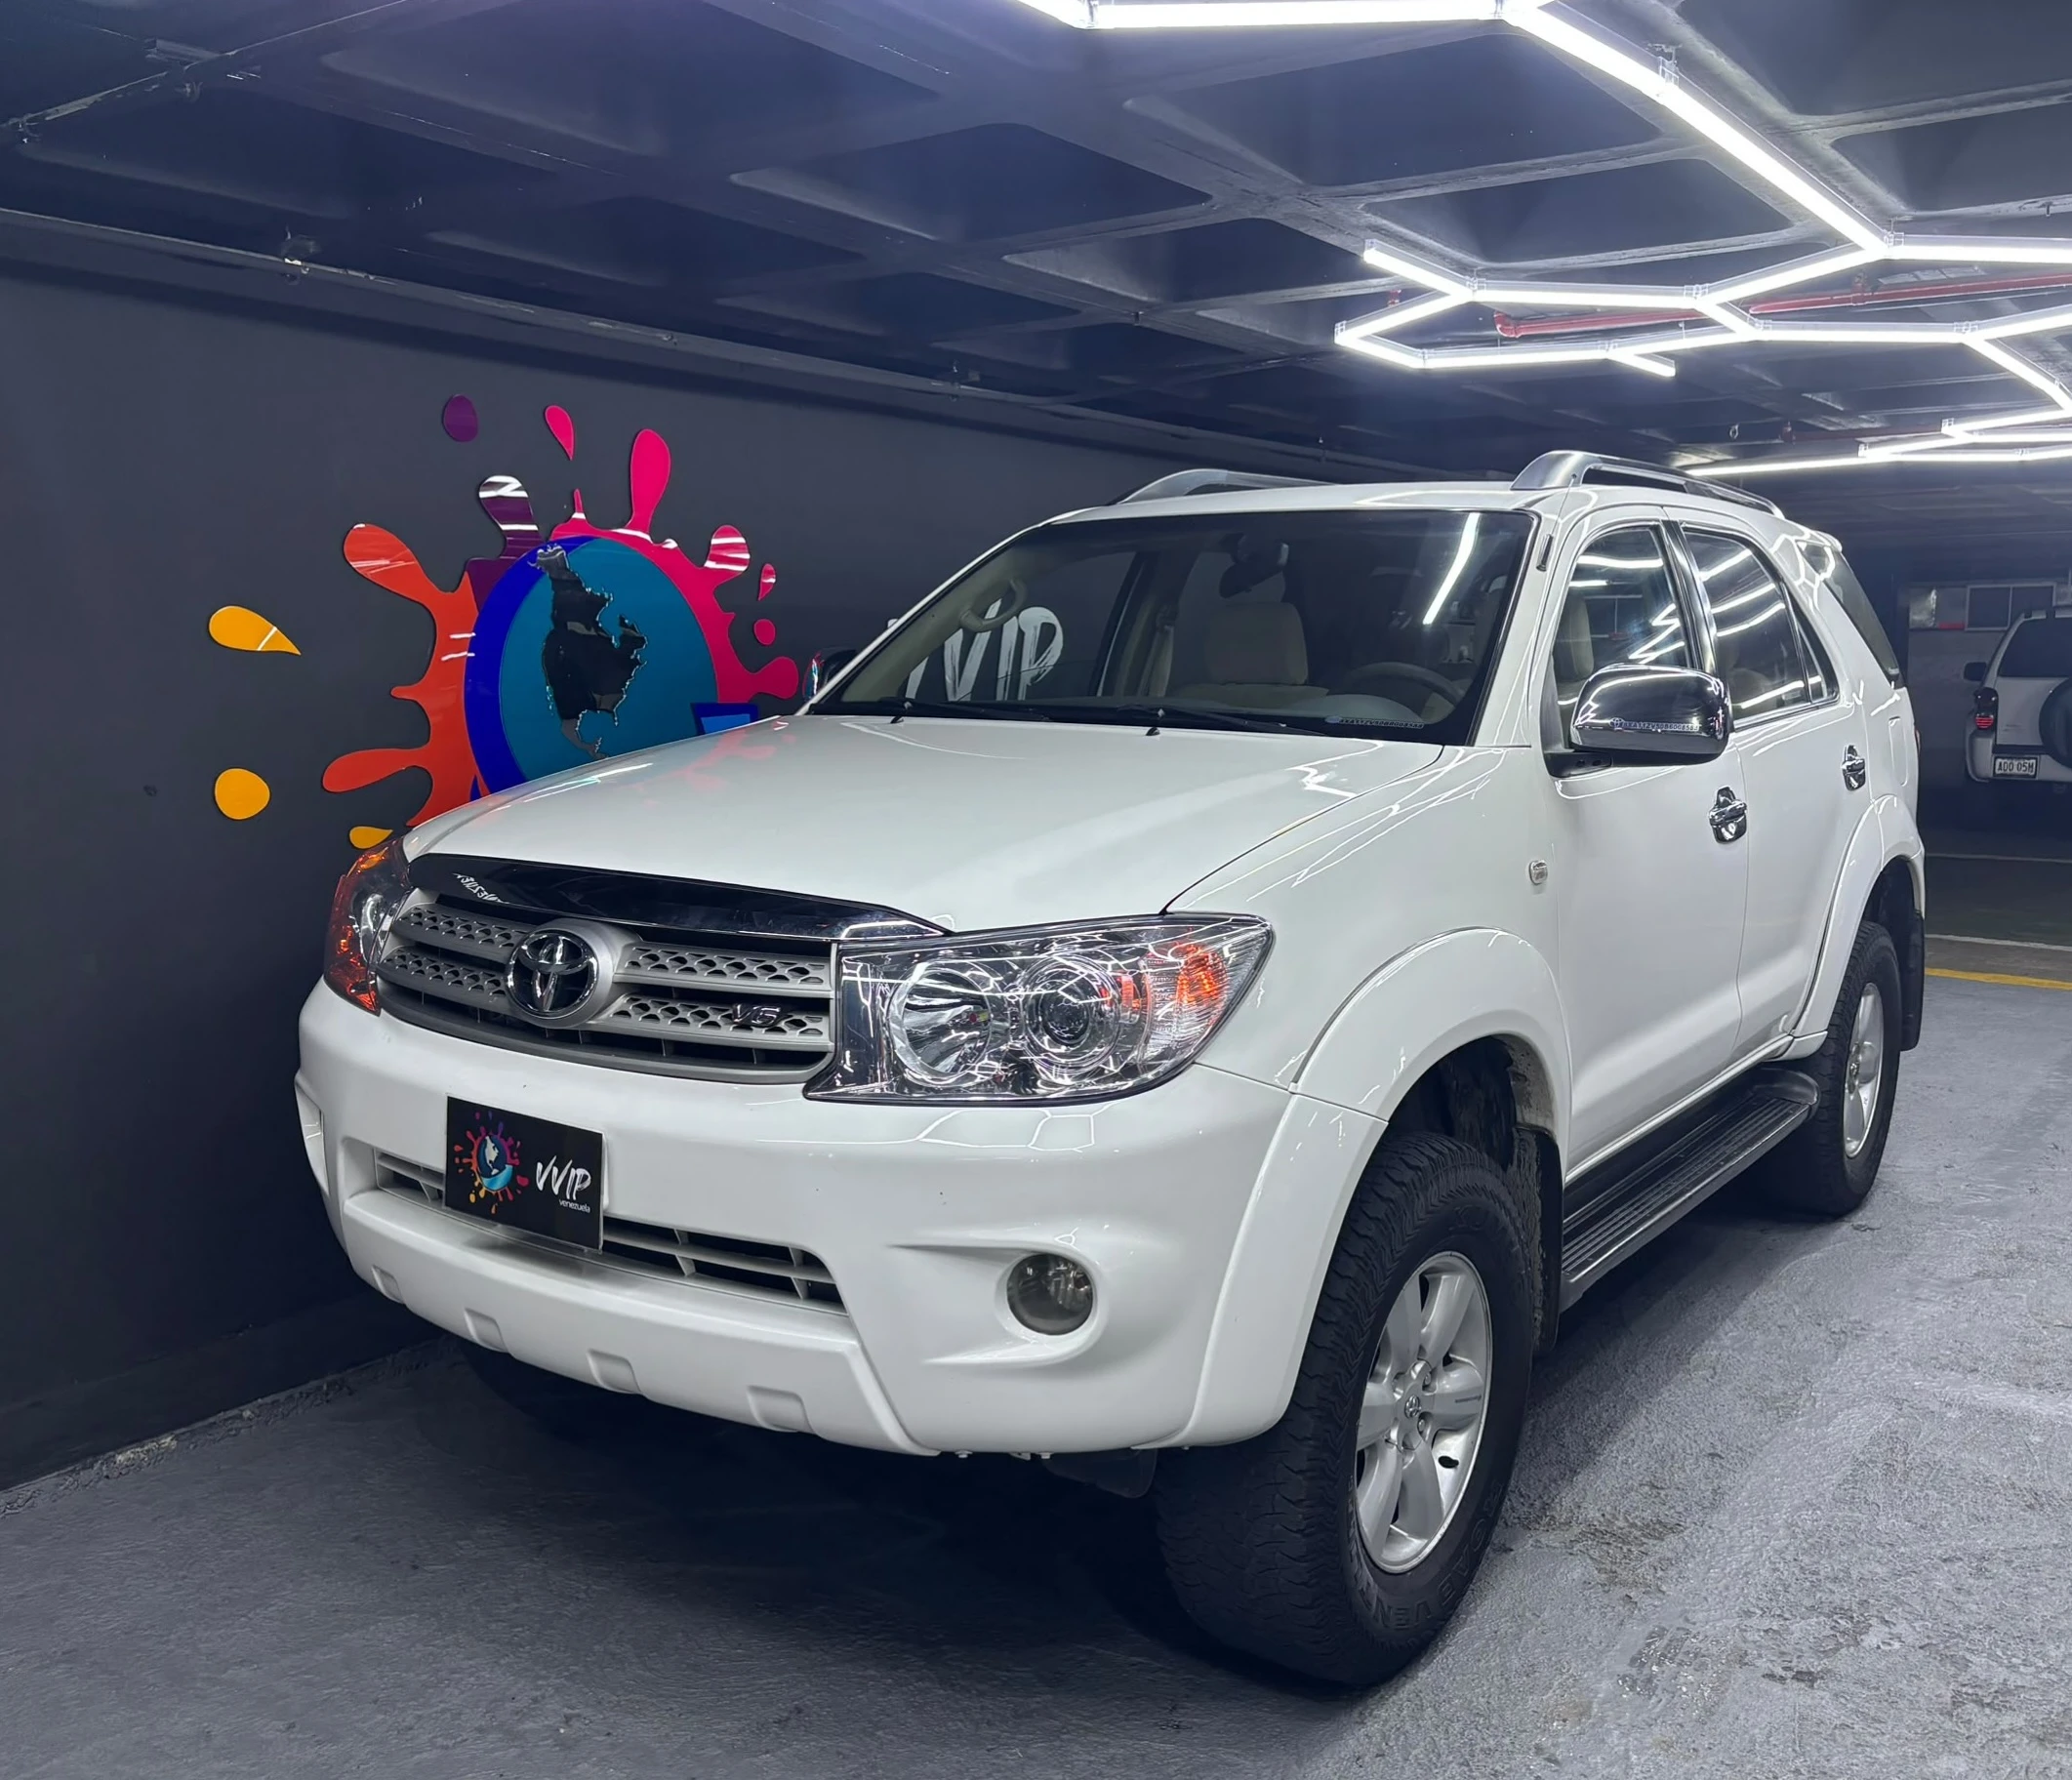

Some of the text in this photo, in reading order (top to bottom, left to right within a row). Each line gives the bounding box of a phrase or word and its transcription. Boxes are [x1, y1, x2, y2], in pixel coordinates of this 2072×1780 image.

[732, 1003, 781, 1028] V6
[536, 1155, 591, 1200] VVIP
[558, 1198, 591, 1213] venezuela
